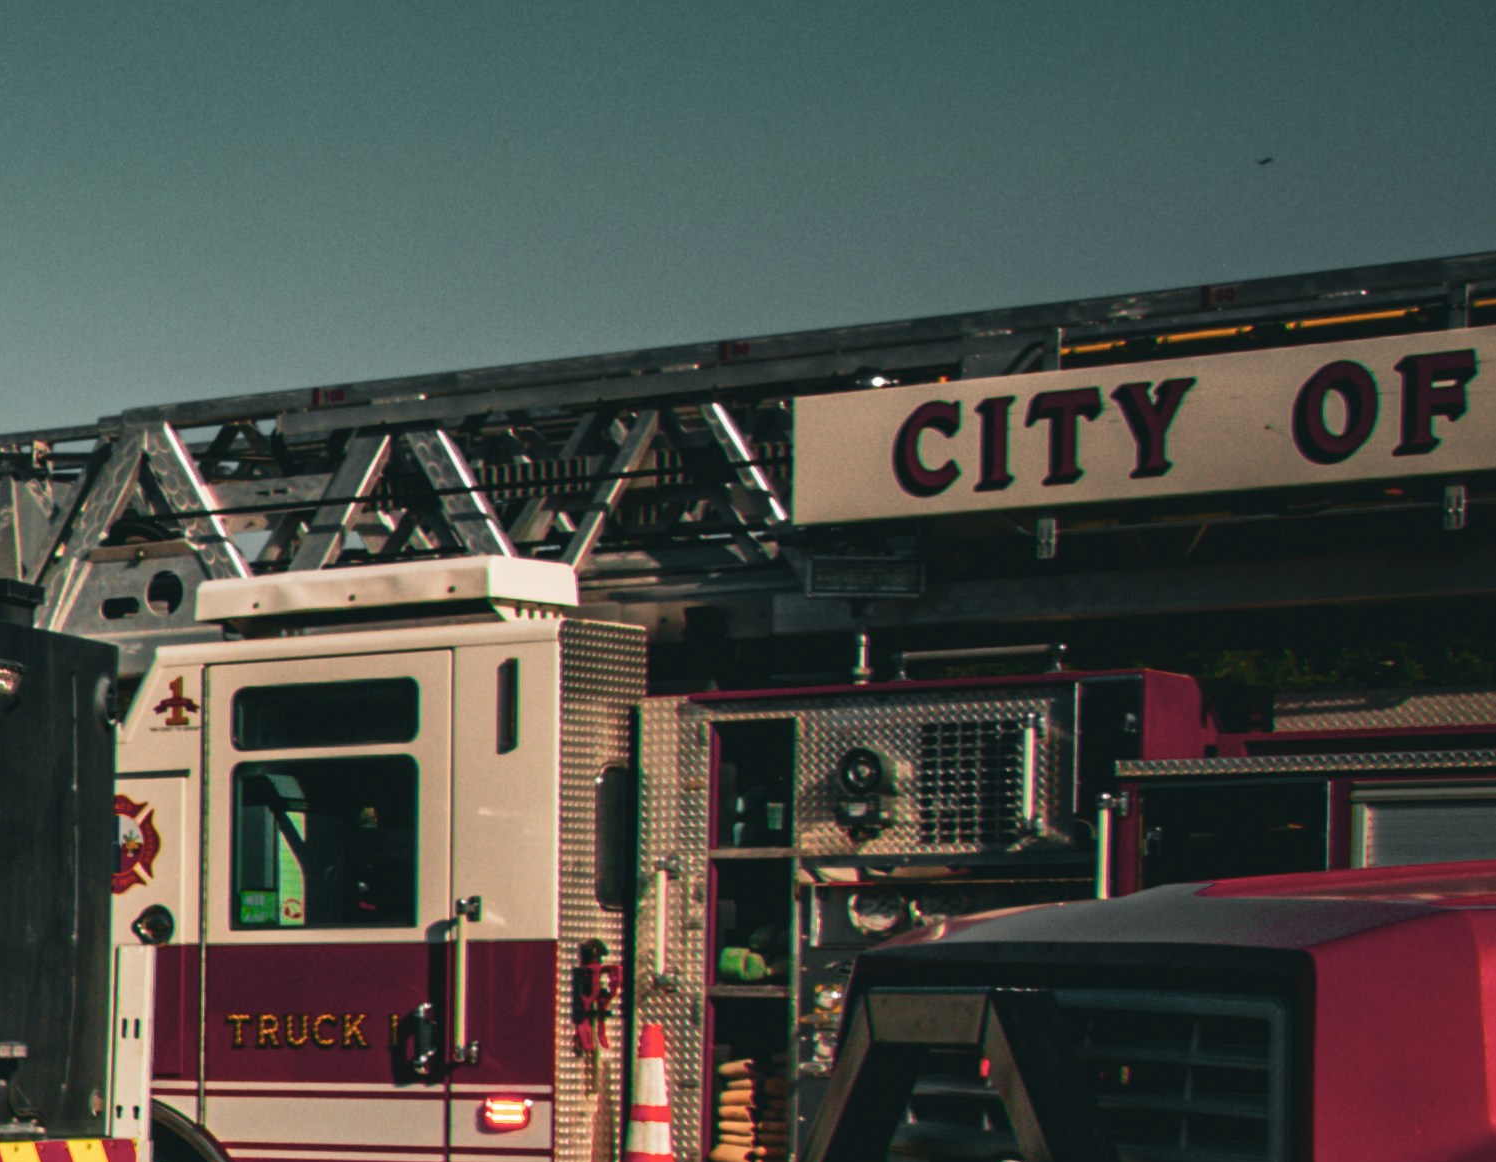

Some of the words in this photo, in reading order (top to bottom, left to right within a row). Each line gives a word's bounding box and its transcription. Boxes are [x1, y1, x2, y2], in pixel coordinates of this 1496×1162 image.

[892, 377, 1197, 498] CITY
[1292, 349, 1479, 465] OF
[225, 1012, 370, 1049] TRUCK
